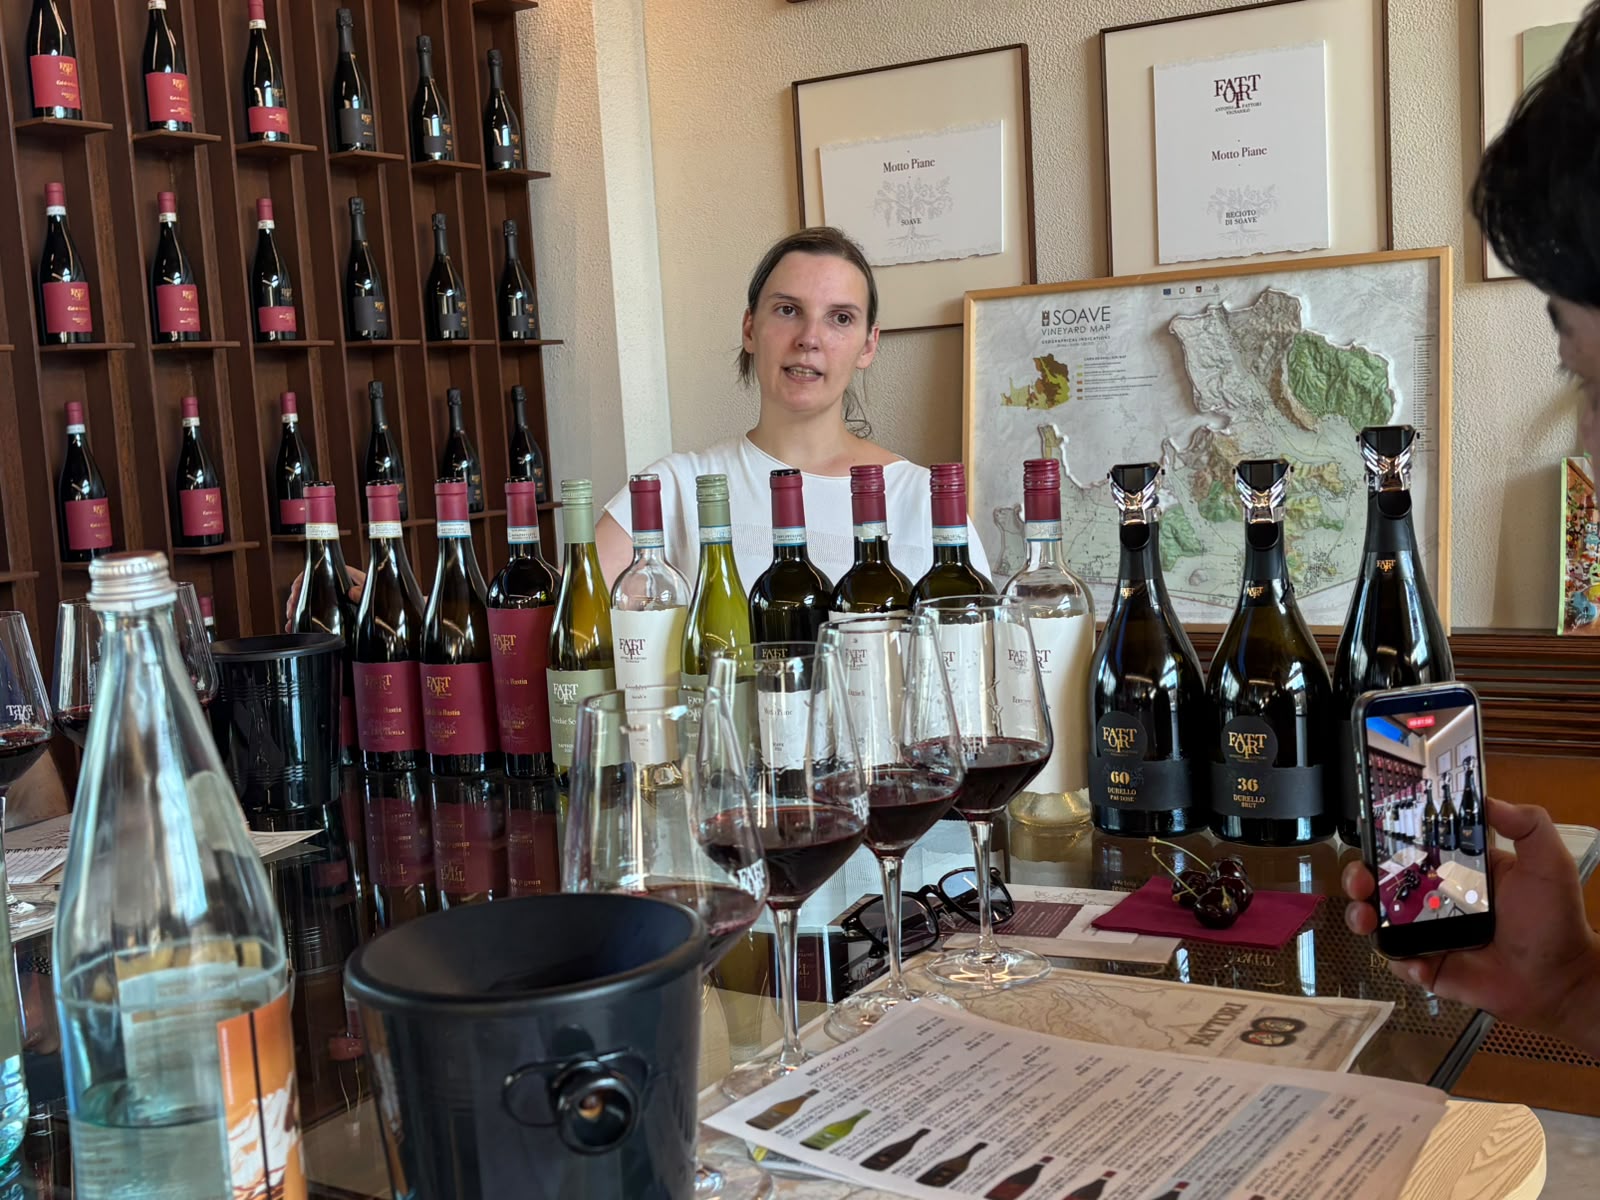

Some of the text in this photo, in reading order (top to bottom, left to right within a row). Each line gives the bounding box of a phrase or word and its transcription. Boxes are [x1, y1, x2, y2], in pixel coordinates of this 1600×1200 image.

[1211, 148, 1240, 161] Motto
[882, 161, 910, 173] Motto
[1225, 209, 1257, 219] RECIOTO
[900, 217, 922, 226] SOAVE
[1234, 216, 1258, 225] SOAVE
[1052, 305, 1111, 326] SOAVE
[1041, 323, 1111, 336] VINEYARD MAP
[1110, 770, 1131, 785] 60
[1236, 776, 1260, 792] 36
[1107, 786, 1137, 796] DURELLO
[1232, 793, 1267, 803] DURELLO
